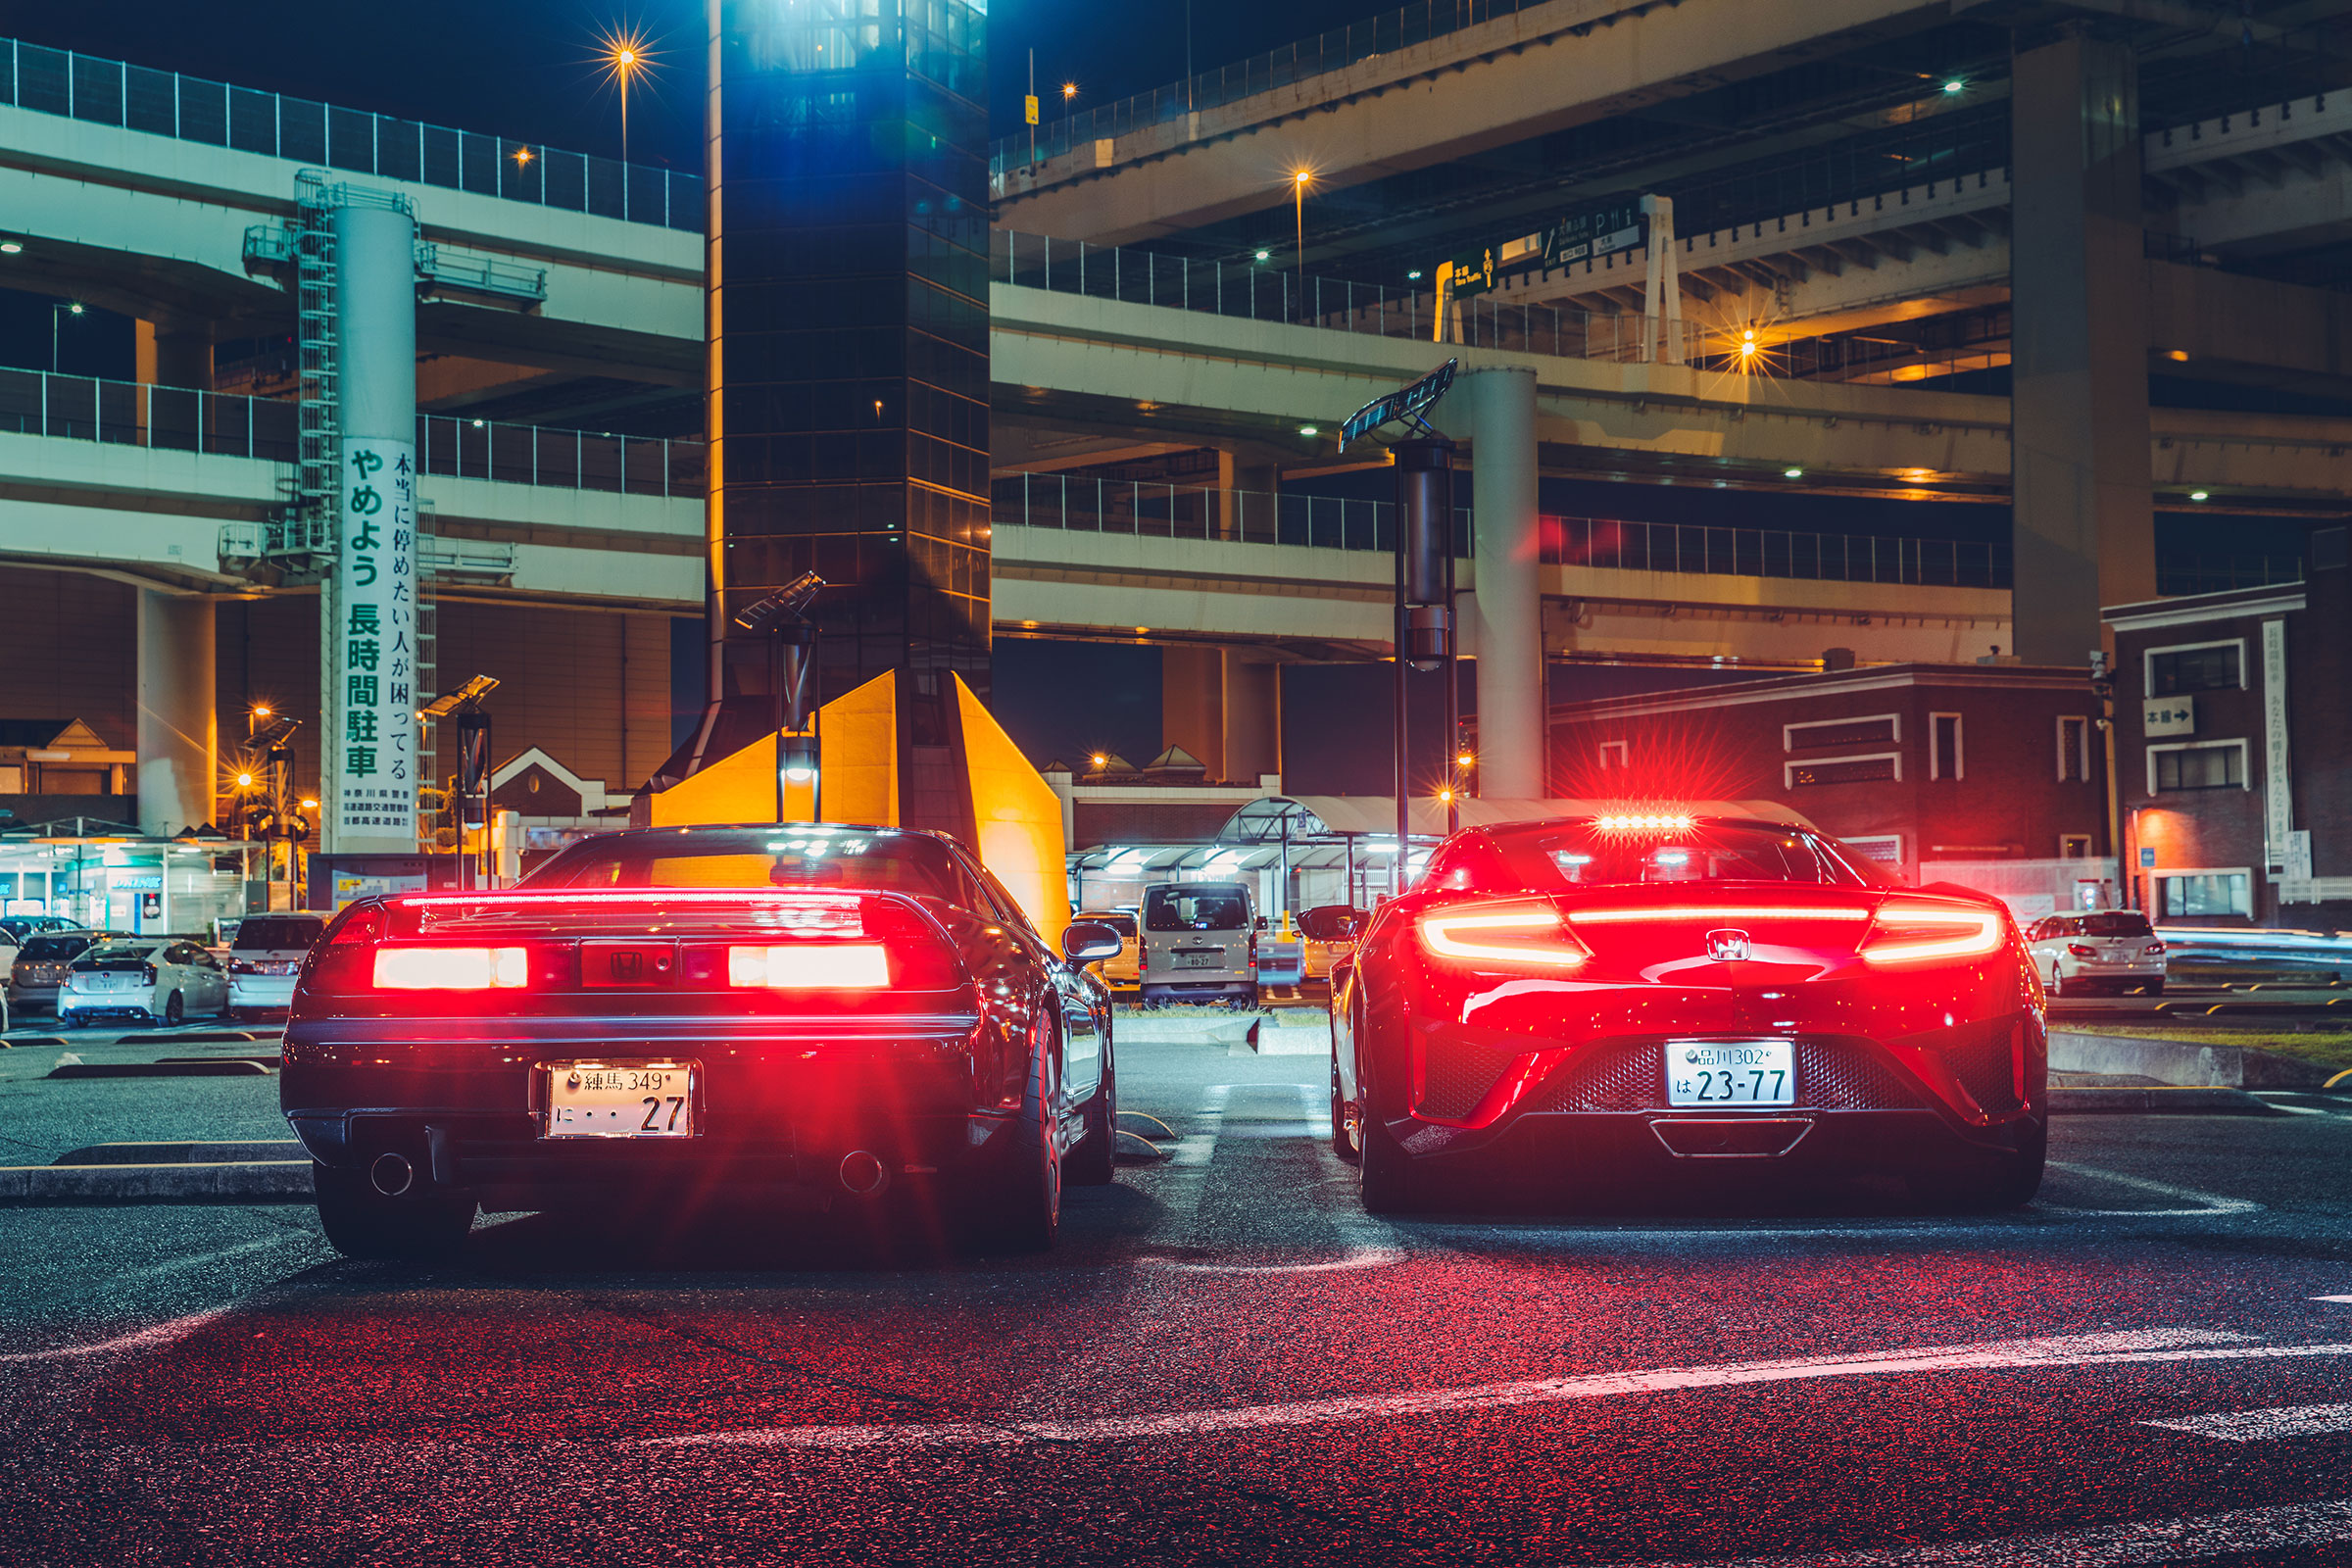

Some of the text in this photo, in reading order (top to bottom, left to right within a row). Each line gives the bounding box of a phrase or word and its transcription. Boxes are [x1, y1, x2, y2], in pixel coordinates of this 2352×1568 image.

[345, 449, 384, 779] やめよう 長時間駐車
[390, 452, 412, 780] 本当に停めたい人が困ってる
[1697, 1049, 1764, 1065] 品川 302
[584, 1072, 662, 1091] 練馬 349
[1677, 1070, 1786, 1101] は 23-77
[640, 1096, 685, 1132] 27
